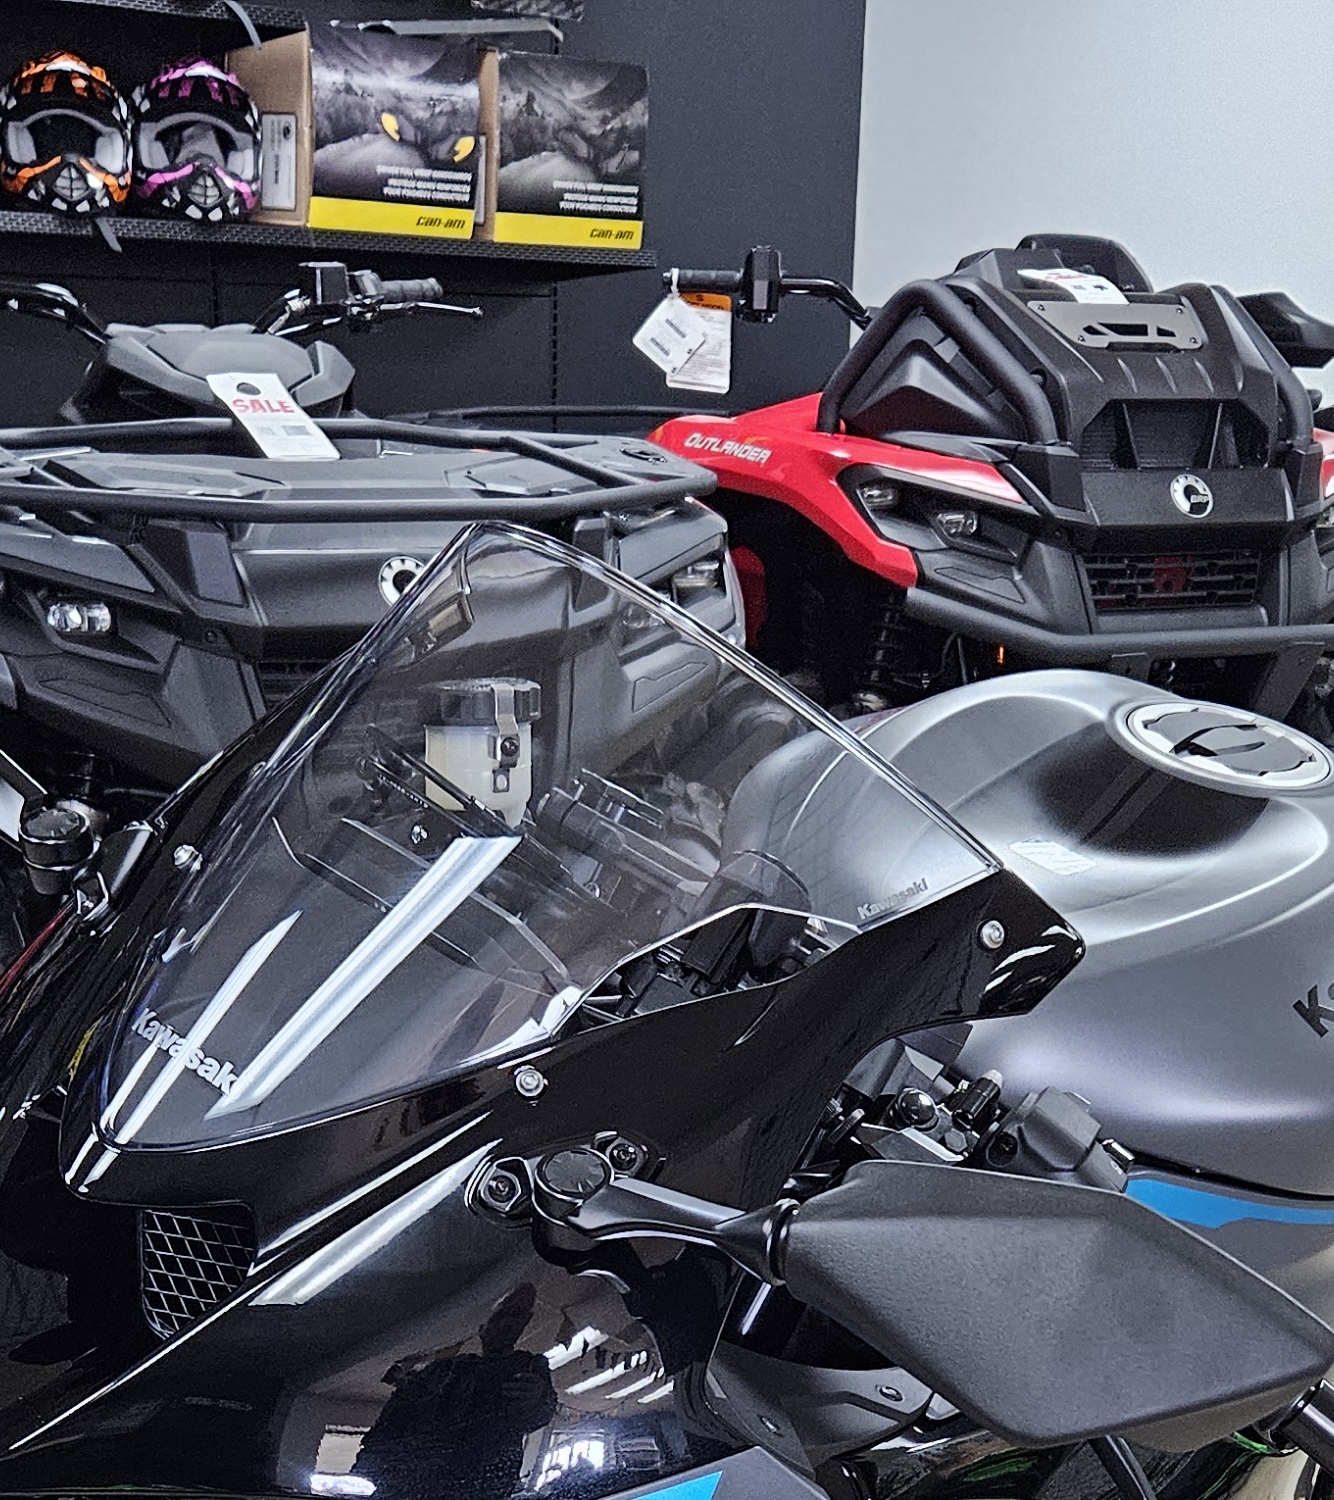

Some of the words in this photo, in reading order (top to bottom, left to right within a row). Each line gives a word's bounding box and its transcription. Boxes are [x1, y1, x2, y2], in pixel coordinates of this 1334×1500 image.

[416, 214, 466, 229] can-am
[590, 227, 635, 241] can-am
[232, 399, 295, 414] SALE
[684, 432, 772, 464] OUTLANDER
[857, 877, 929, 920] Kawasaki
[131, 1007, 240, 1096] Kawasak
